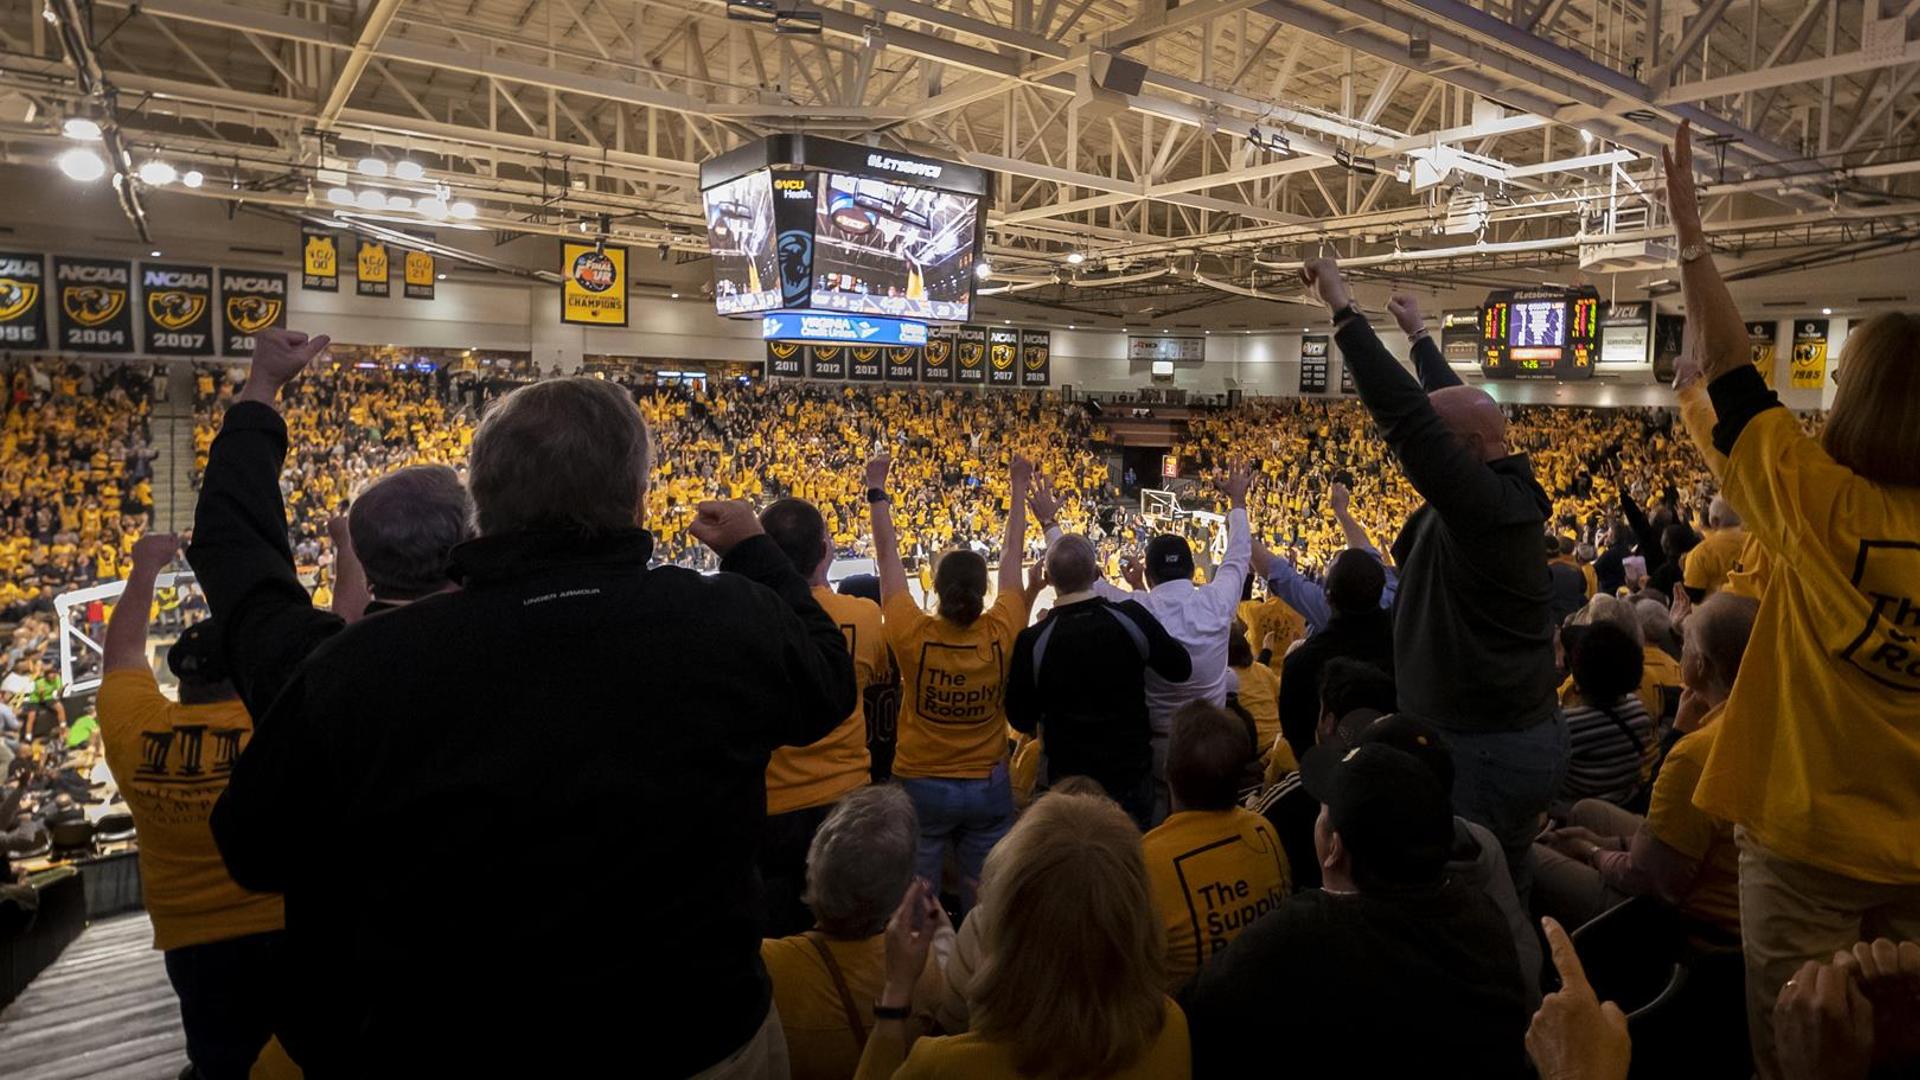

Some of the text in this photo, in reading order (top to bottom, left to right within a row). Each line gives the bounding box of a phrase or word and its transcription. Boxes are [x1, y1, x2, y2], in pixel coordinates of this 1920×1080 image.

[784, 180, 805, 190] VCU
[58, 265, 127, 283] NCAA
[144, 271, 209, 289] NCAA
[223, 276, 284, 294] NCAA
[569, 298, 622, 309] CHAMPIONS
[69, 330, 124, 345] 2004
[154, 333, 205, 348] 2007
[231, 337, 256, 350] 20
[991, 332, 1017, 342] NCAA
[775, 361, 798, 371] 2011
[816, 363, 840, 373] 2012
[855, 365, 878, 375] 2013
[891, 366, 913, 376] 2014
[927, 368, 949, 377] 2015
[993, 371, 1013, 380] 2017
[560, 588, 600, 597] ARMOUR
[1867, 591, 1920, 627] Th
[928, 668, 966, 686] The
[925, 685, 997, 706] Supply
[925, 702, 985, 717] Room
[1198, 880, 1249, 909] The
